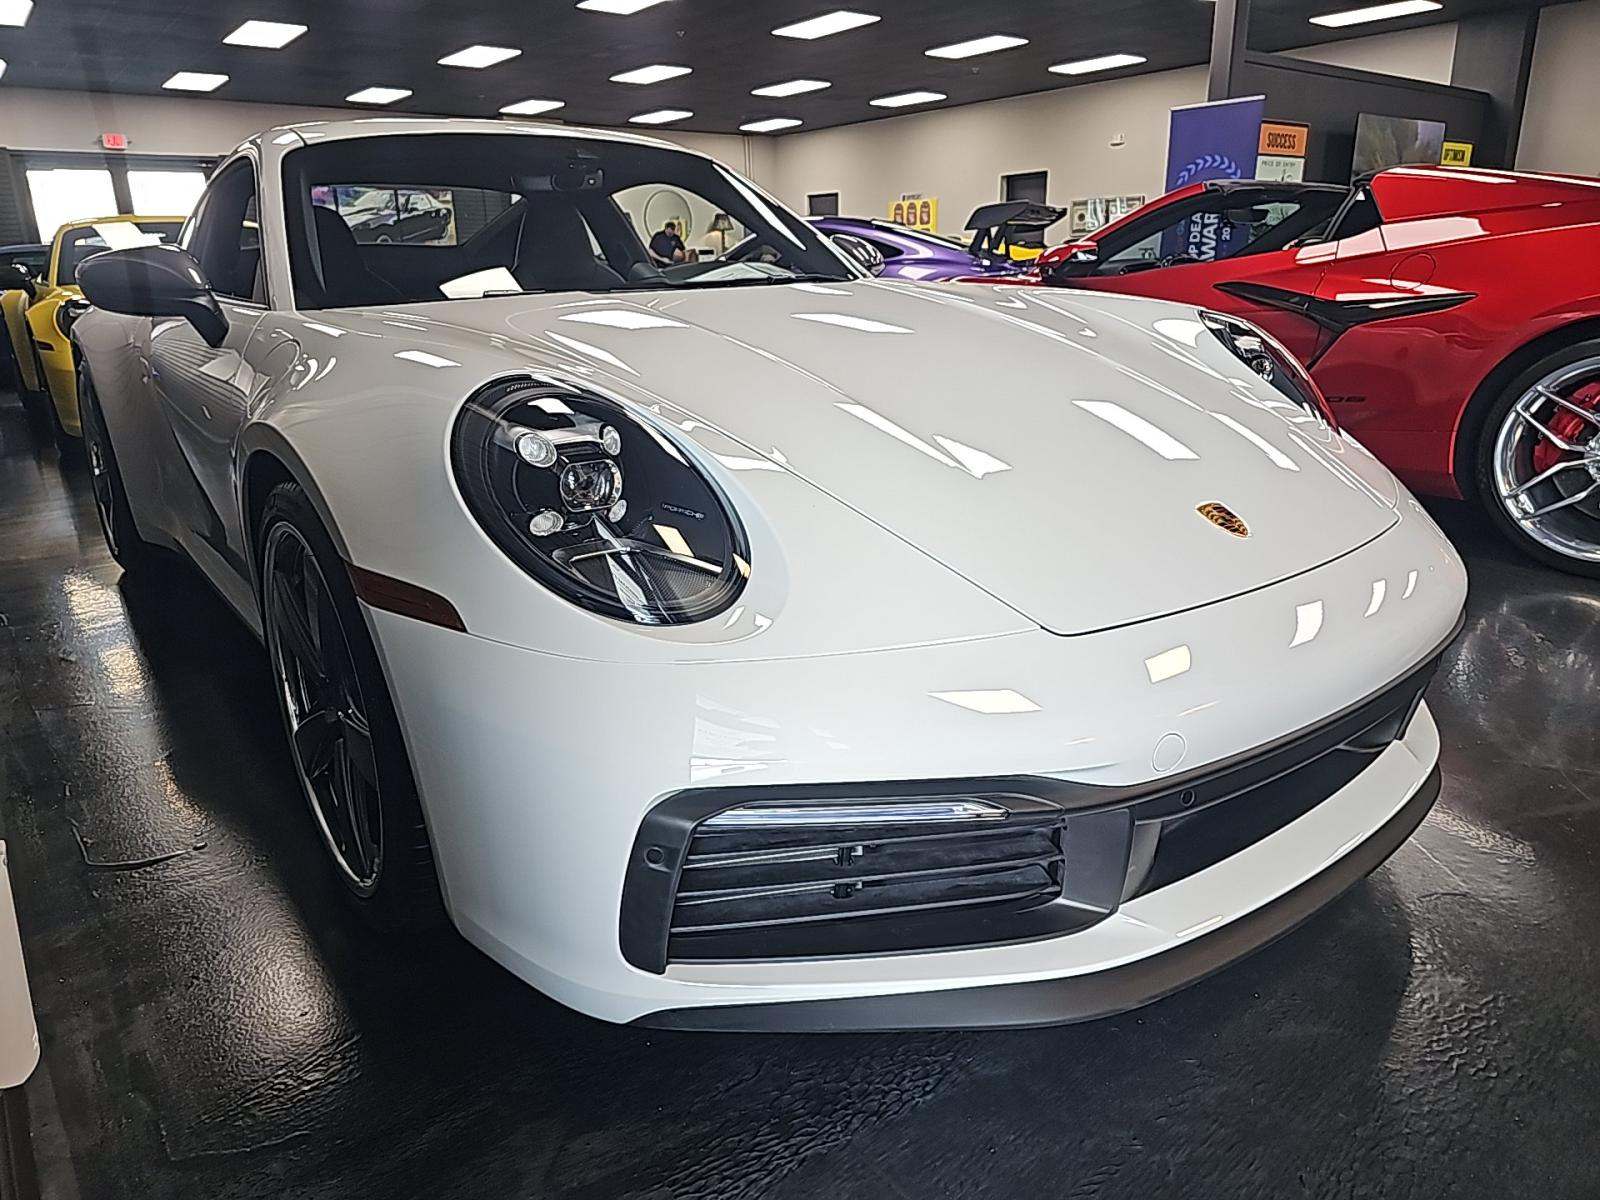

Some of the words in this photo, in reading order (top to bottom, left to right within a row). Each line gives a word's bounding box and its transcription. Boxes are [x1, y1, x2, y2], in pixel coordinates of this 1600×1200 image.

[1267, 132, 1296, 149] SUCCESS
[1189, 212, 1203, 243] DEA
[1200, 213, 1220, 262] WAR
[1222, 227, 1231, 241] 20
